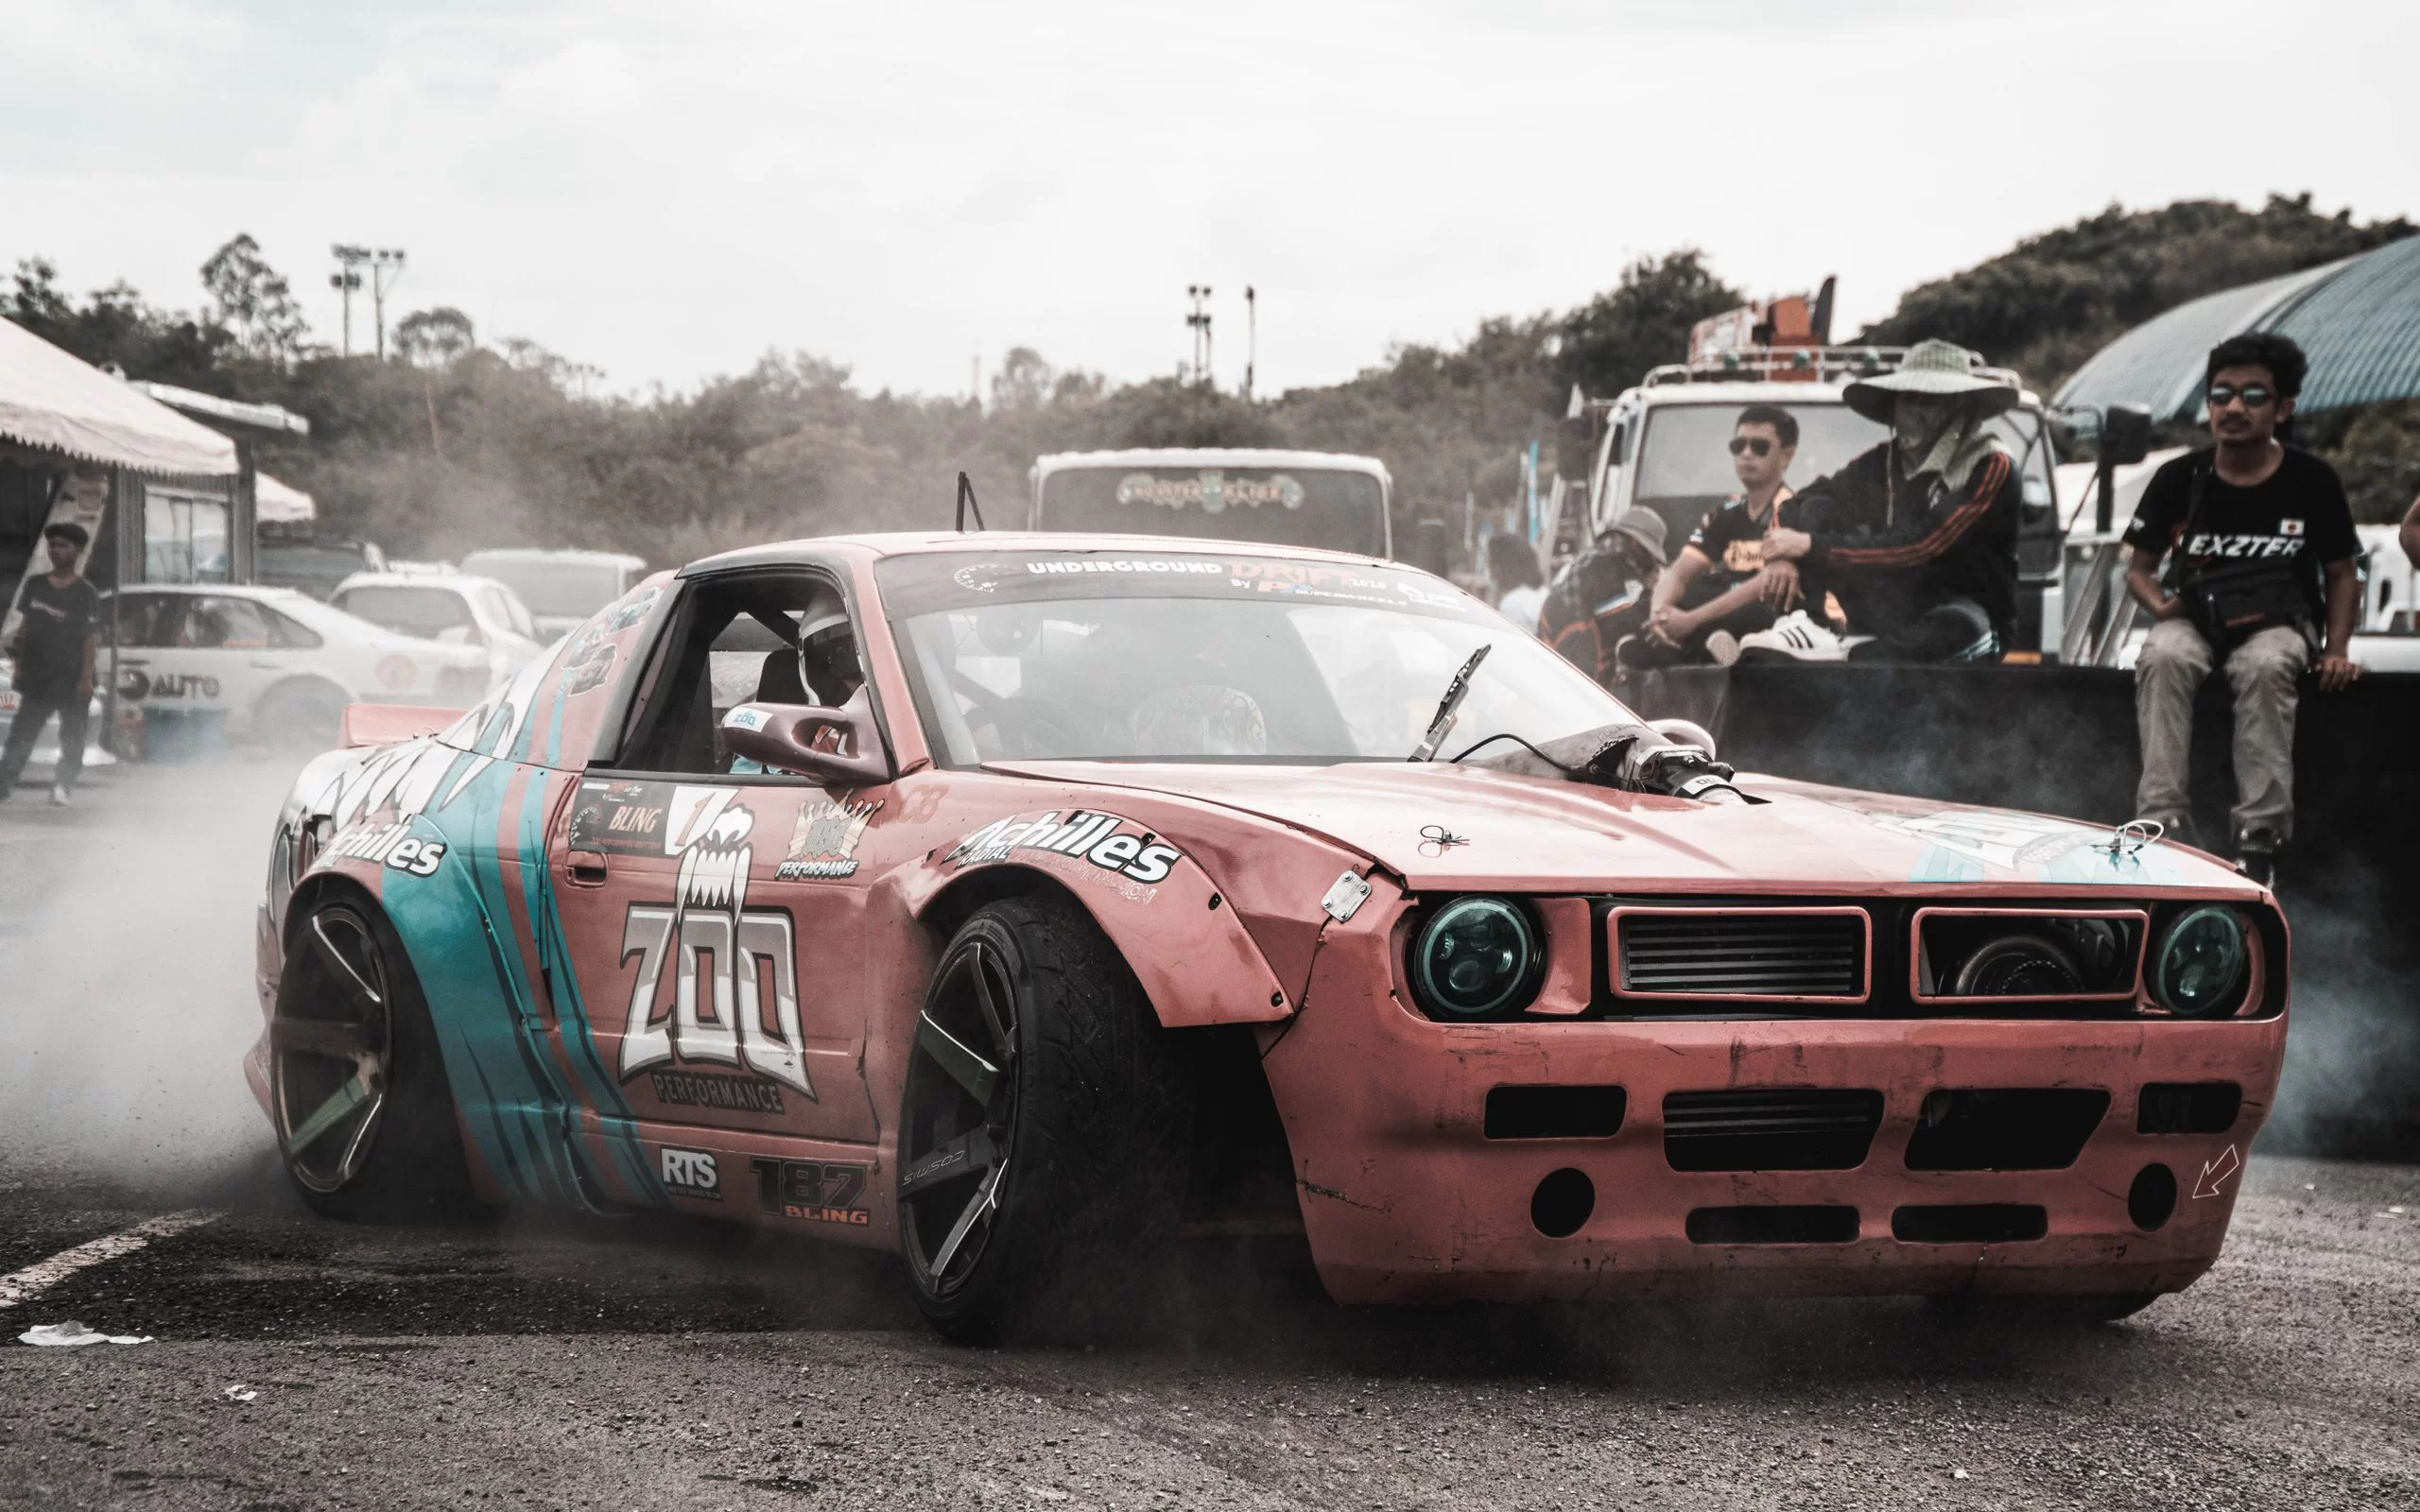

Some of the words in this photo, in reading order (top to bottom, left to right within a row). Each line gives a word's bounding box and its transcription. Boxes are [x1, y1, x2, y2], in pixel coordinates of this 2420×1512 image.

[1027, 560, 1222, 574] UNDERGROUND
[1225, 561, 1362, 587] DRIFT
[1349, 578, 1387, 589] 2020
[1231, 578, 1251, 589] By
[608, 806, 662, 833] BLING
[940, 810, 1183, 884] Achilles
[957, 846, 1012, 868] RADIAL
[775, 859, 859, 880] PERFORMANCE
[619, 902, 819, 1103] ZOO
[652, 1073, 785, 1113] PERFORMANCE
[661, 1147, 718, 1189] RTS
[902, 1149, 966, 1186] COSMIS
[750, 1157, 868, 1215] 187
[785, 1205, 870, 1226] BLING
